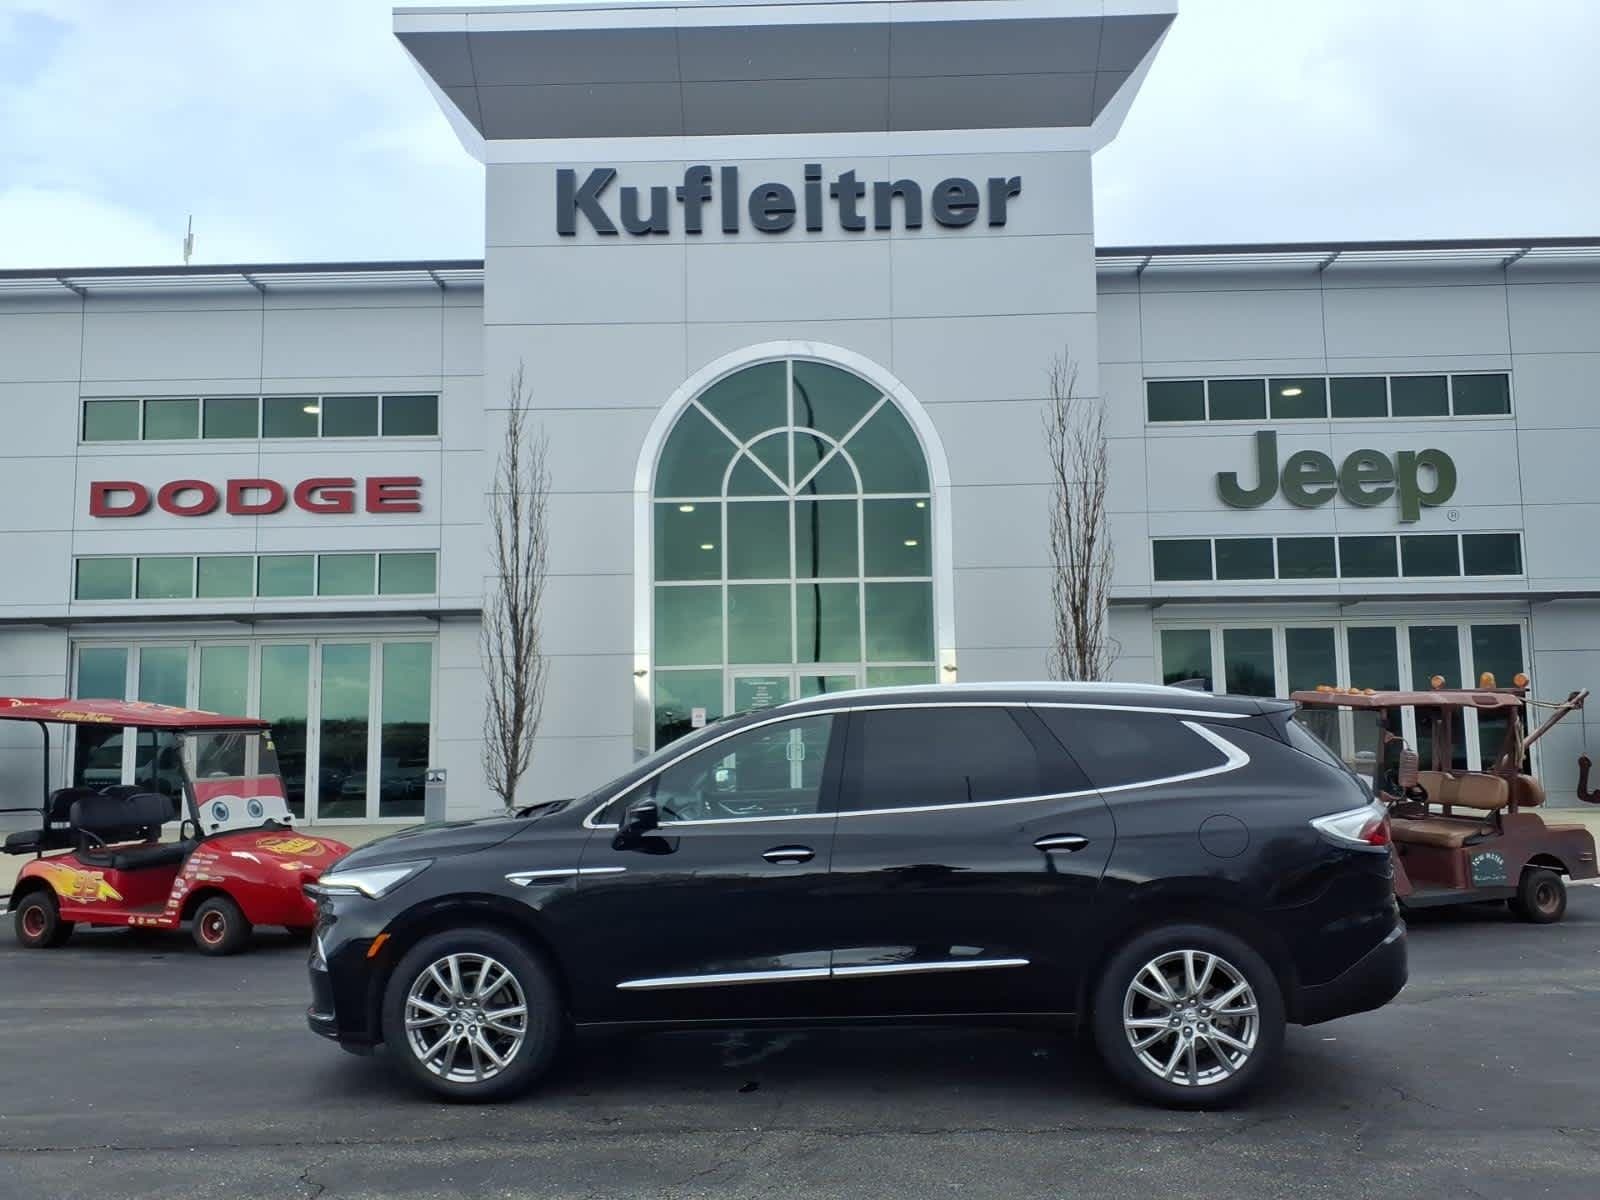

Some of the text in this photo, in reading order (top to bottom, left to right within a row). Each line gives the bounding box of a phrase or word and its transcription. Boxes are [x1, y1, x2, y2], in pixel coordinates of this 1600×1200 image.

[556, 163, 1022, 237] Kufleitner
[89, 476, 423, 518] DODGE
[1216, 430, 1458, 524] Jeep
